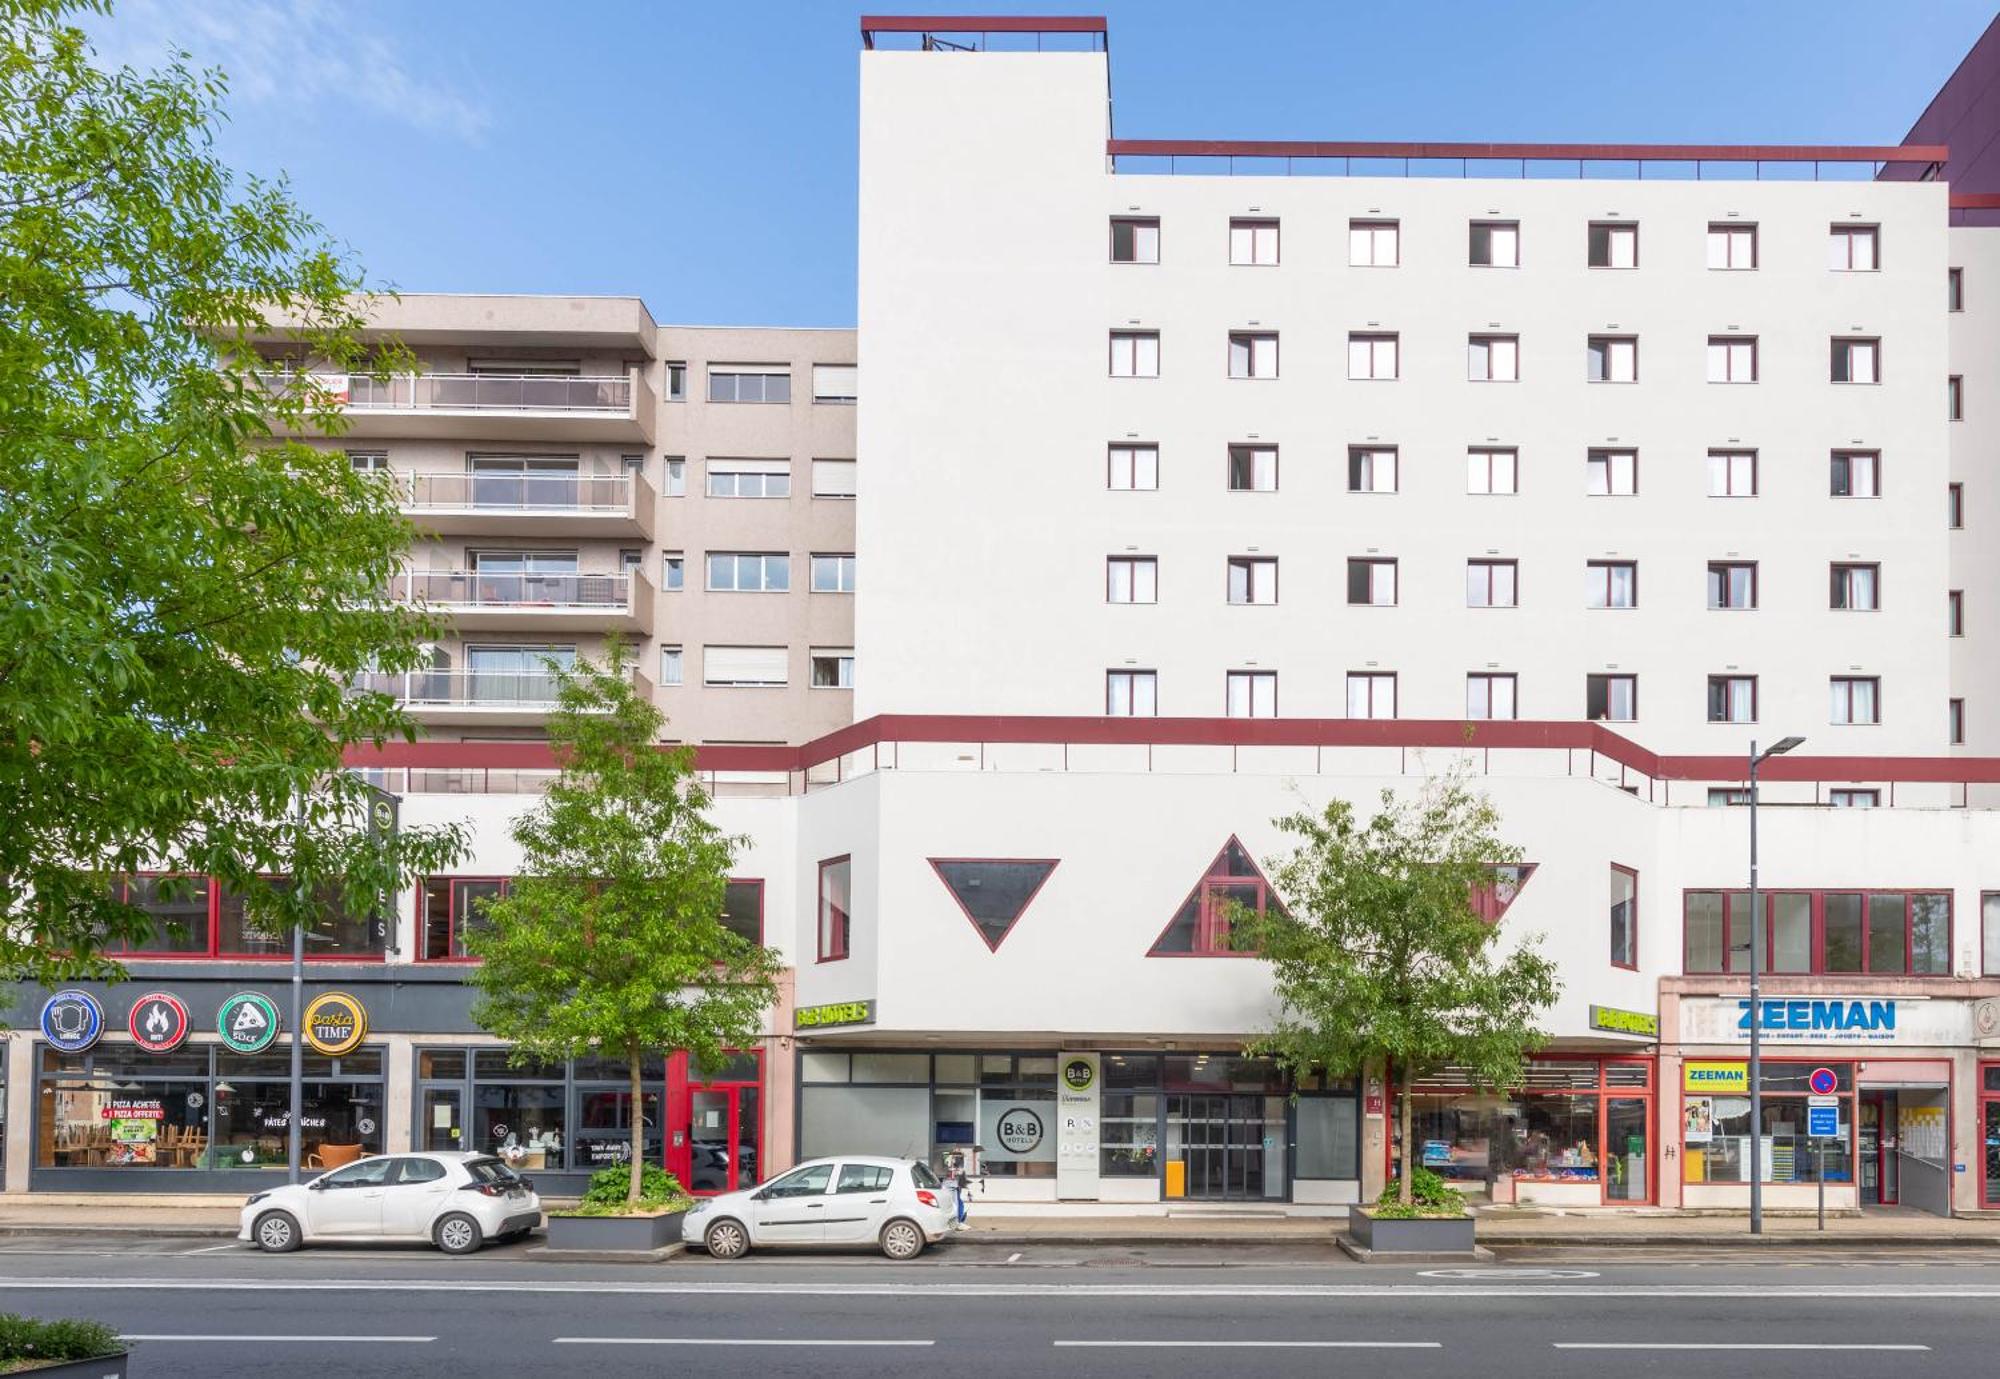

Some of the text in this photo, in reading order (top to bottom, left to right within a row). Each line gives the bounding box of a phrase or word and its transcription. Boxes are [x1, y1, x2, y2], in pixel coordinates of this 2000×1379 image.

[1738, 1001, 1895, 1029] ZEEMAN
[316, 1026, 351, 1039] TIME
[1067, 1068, 1090, 1079] B&B
[1690, 1070, 1744, 1081] ZEEMAN
[1004, 1122, 1037, 1136] B&B
